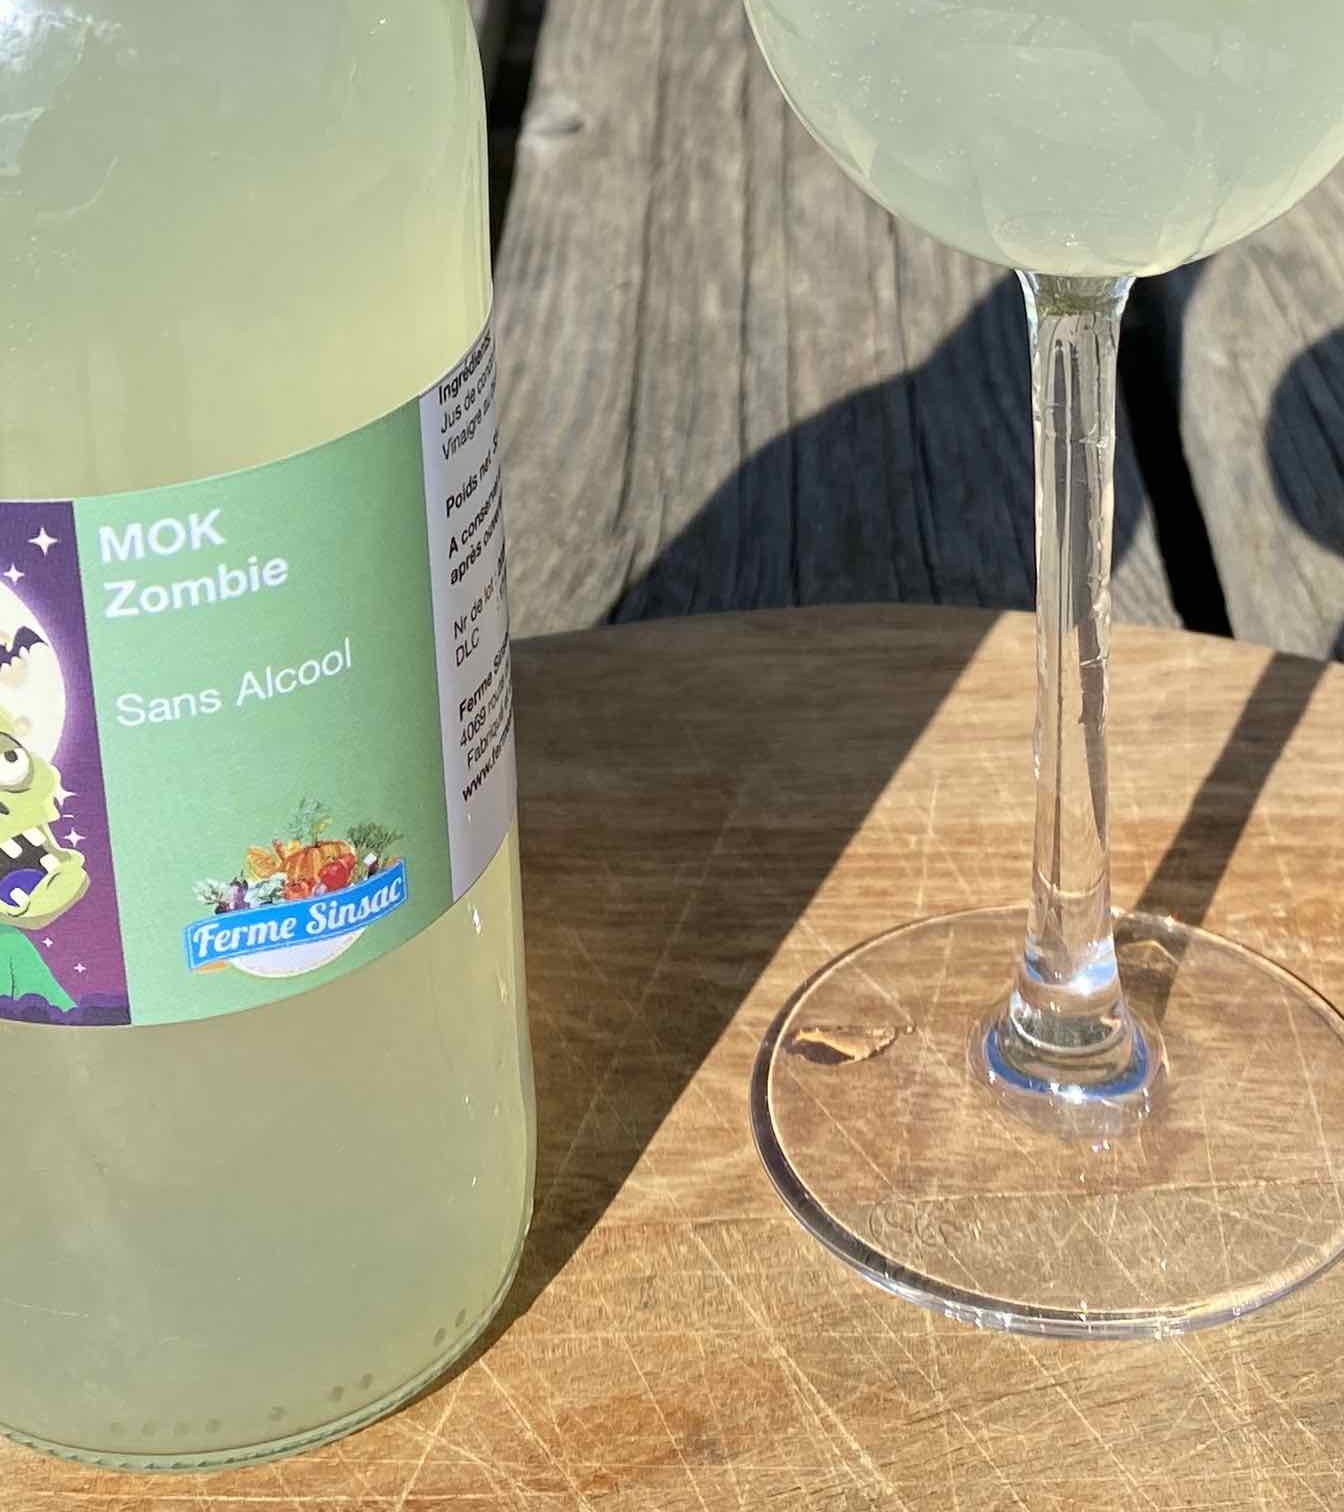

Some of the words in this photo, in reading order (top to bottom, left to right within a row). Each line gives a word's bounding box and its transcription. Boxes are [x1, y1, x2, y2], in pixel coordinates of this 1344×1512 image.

[440, 404, 462, 434] Jus
[445, 473, 478, 519] Poids
[97, 507, 226, 565] MOK
[449, 535, 459, 560] A
[450, 540, 482, 585] après
[104, 554, 290, 620] Zombie
[455, 626, 480, 668] DLC
[116, 688, 222, 728] Sans
[237, 636, 353, 708] Alcool
[459, 671, 493, 722] Ferme
[190, 908, 297, 961] Ferme
[304, 871, 405, 936] Sinsac
